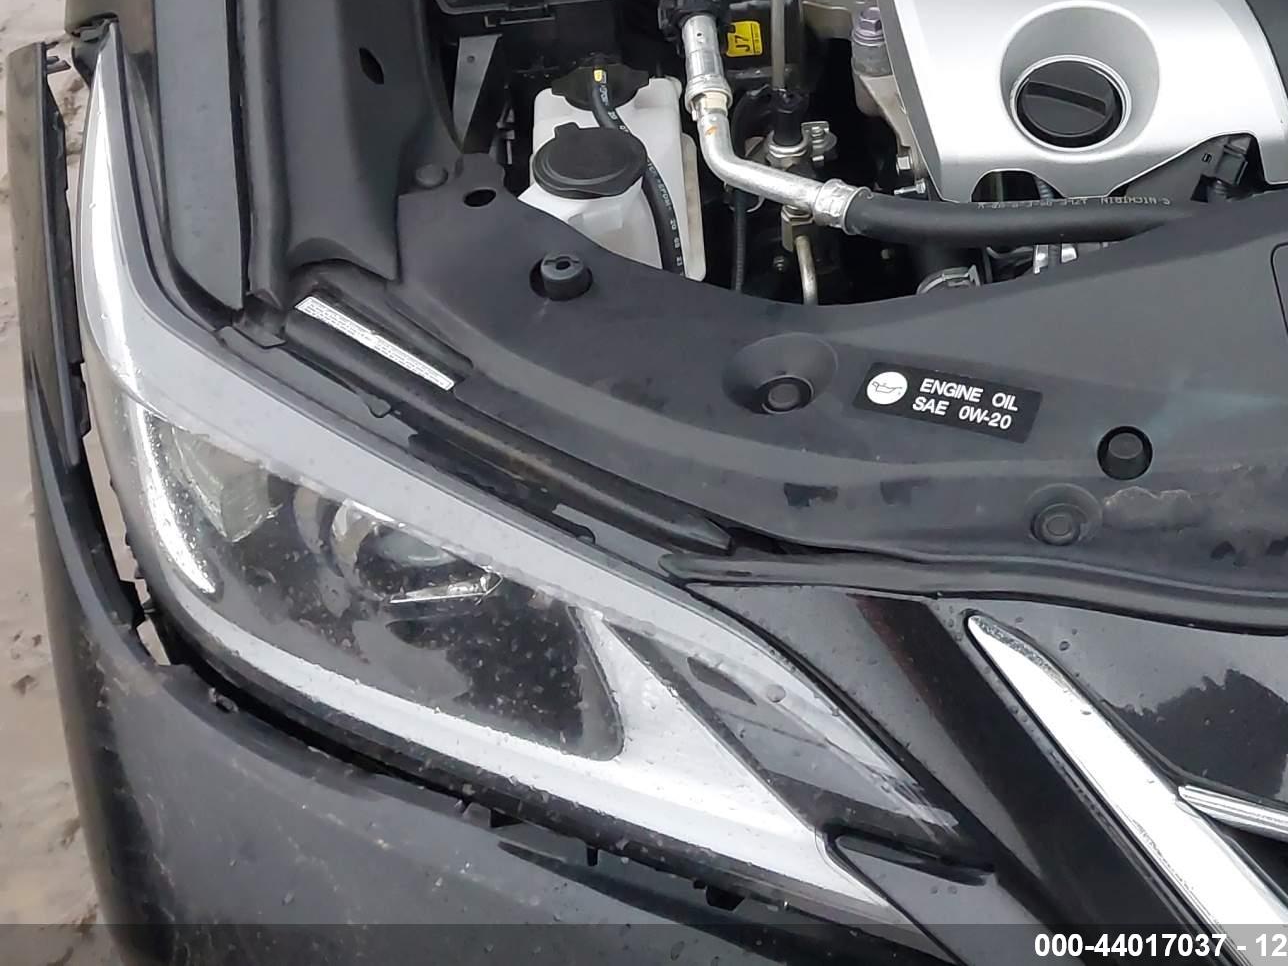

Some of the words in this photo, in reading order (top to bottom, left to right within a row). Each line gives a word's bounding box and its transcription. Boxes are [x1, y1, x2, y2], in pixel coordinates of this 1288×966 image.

[735, 34, 750, 52] J7
[919, 378, 983, 402] ENGINE
[991, 392, 1018, 411] OIL
[912, 396, 950, 416] SAE
[958, 405, 1012, 429] 0W-20
